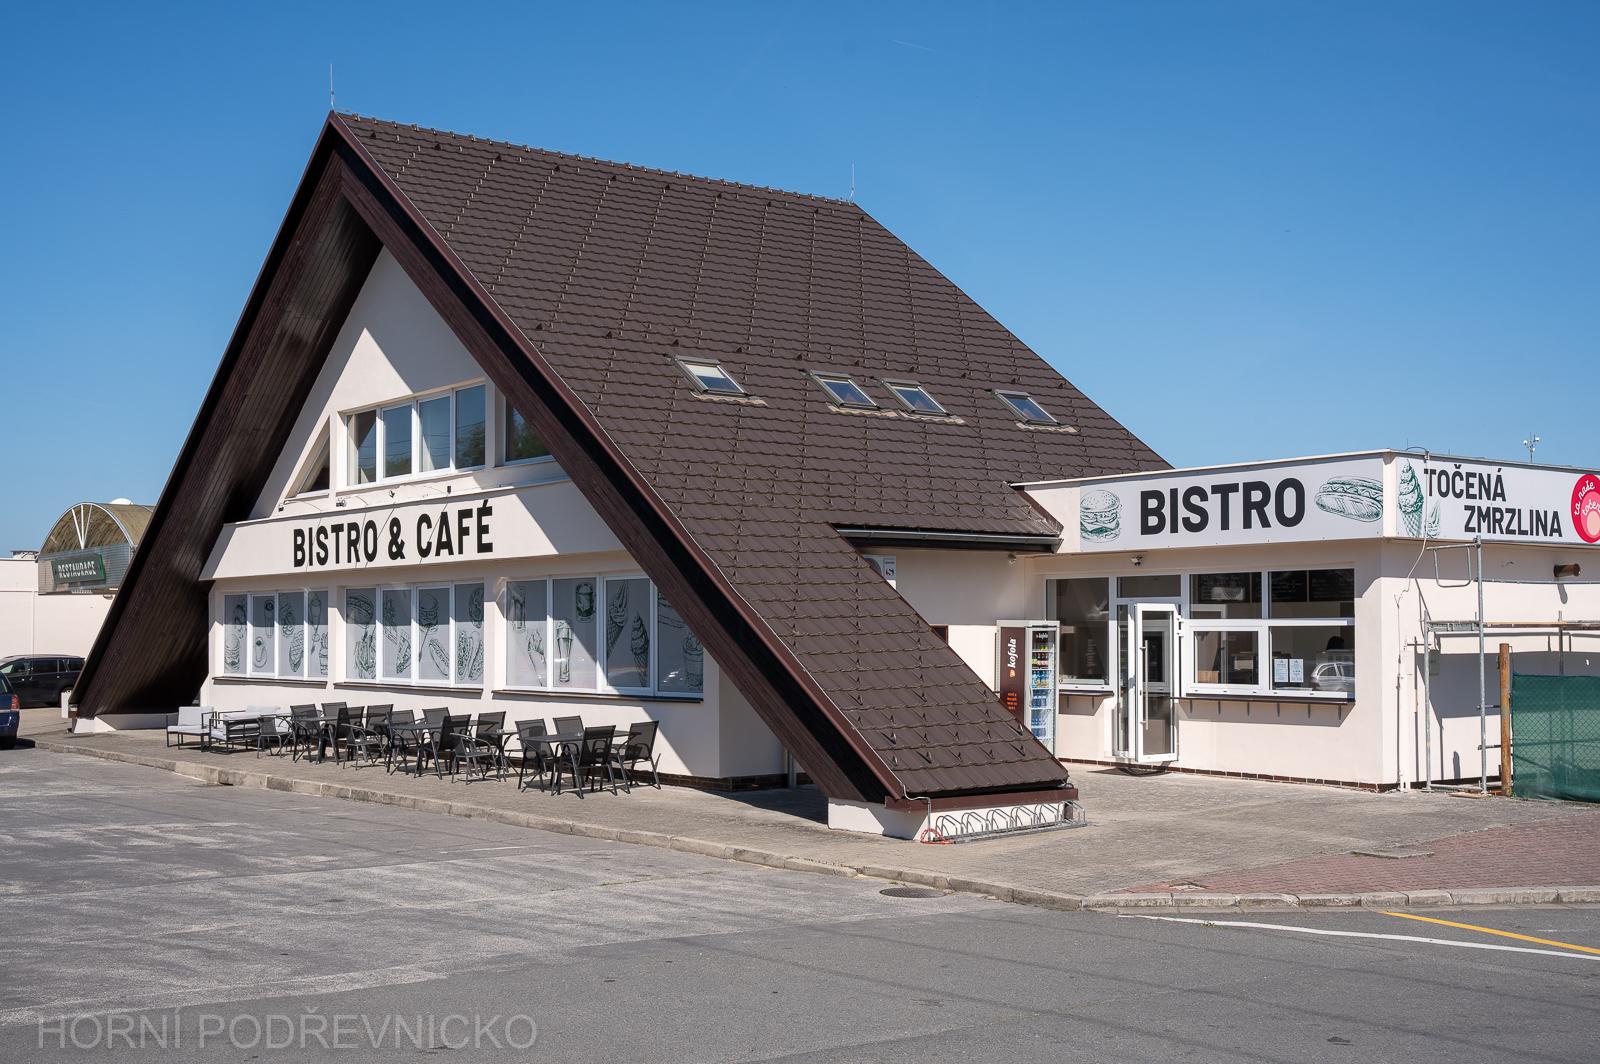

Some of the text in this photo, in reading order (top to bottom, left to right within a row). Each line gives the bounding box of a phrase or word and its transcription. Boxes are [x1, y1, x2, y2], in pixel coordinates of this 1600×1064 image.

[1423, 463, 1507, 502] TOČENÁ
[1140, 477, 1306, 536] BISTRO
[1463, 504, 1563, 537] ZMRZLINA
[293, 498, 494, 568] BISTRO & CAFÉ
[1007, 638, 1019, 668] kofola
